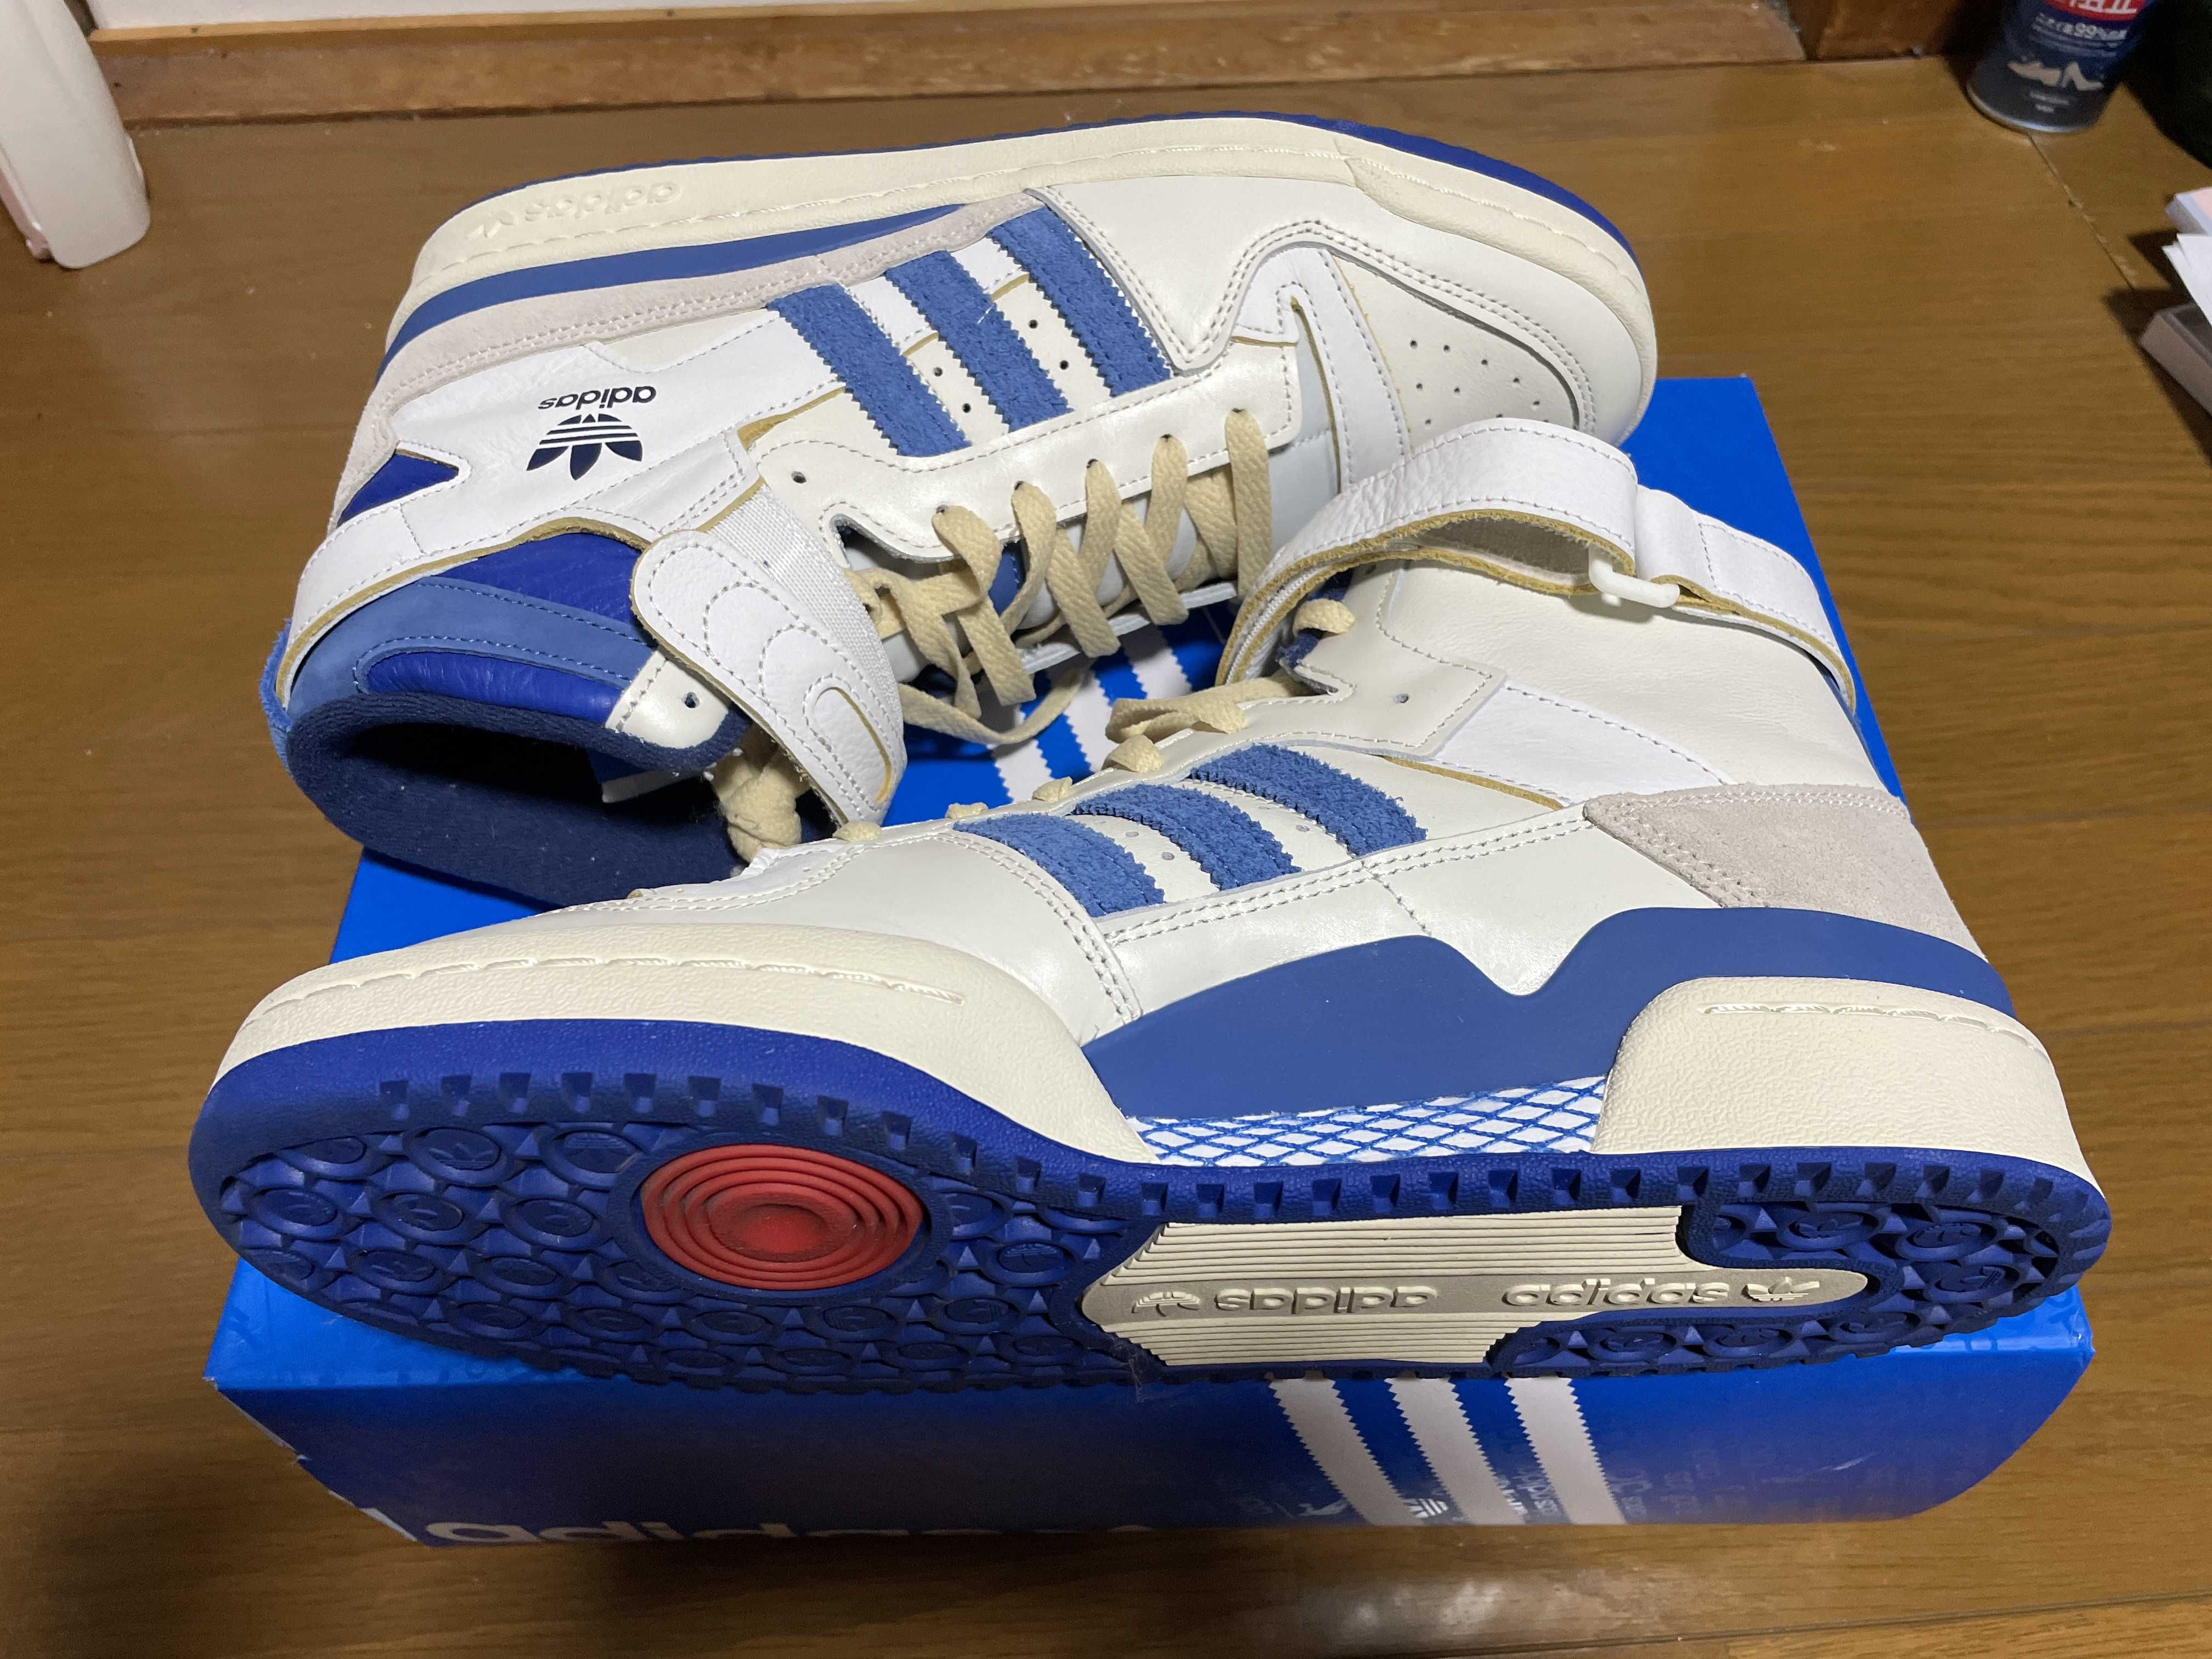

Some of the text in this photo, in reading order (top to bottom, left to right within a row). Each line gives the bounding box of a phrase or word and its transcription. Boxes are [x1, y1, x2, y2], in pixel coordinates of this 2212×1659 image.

[524, 180, 683, 222] adidas
[537, 385, 657, 410] adidas
[1214, 1285, 1438, 1314] adidas
[1502, 1278, 1730, 1306] adidas
